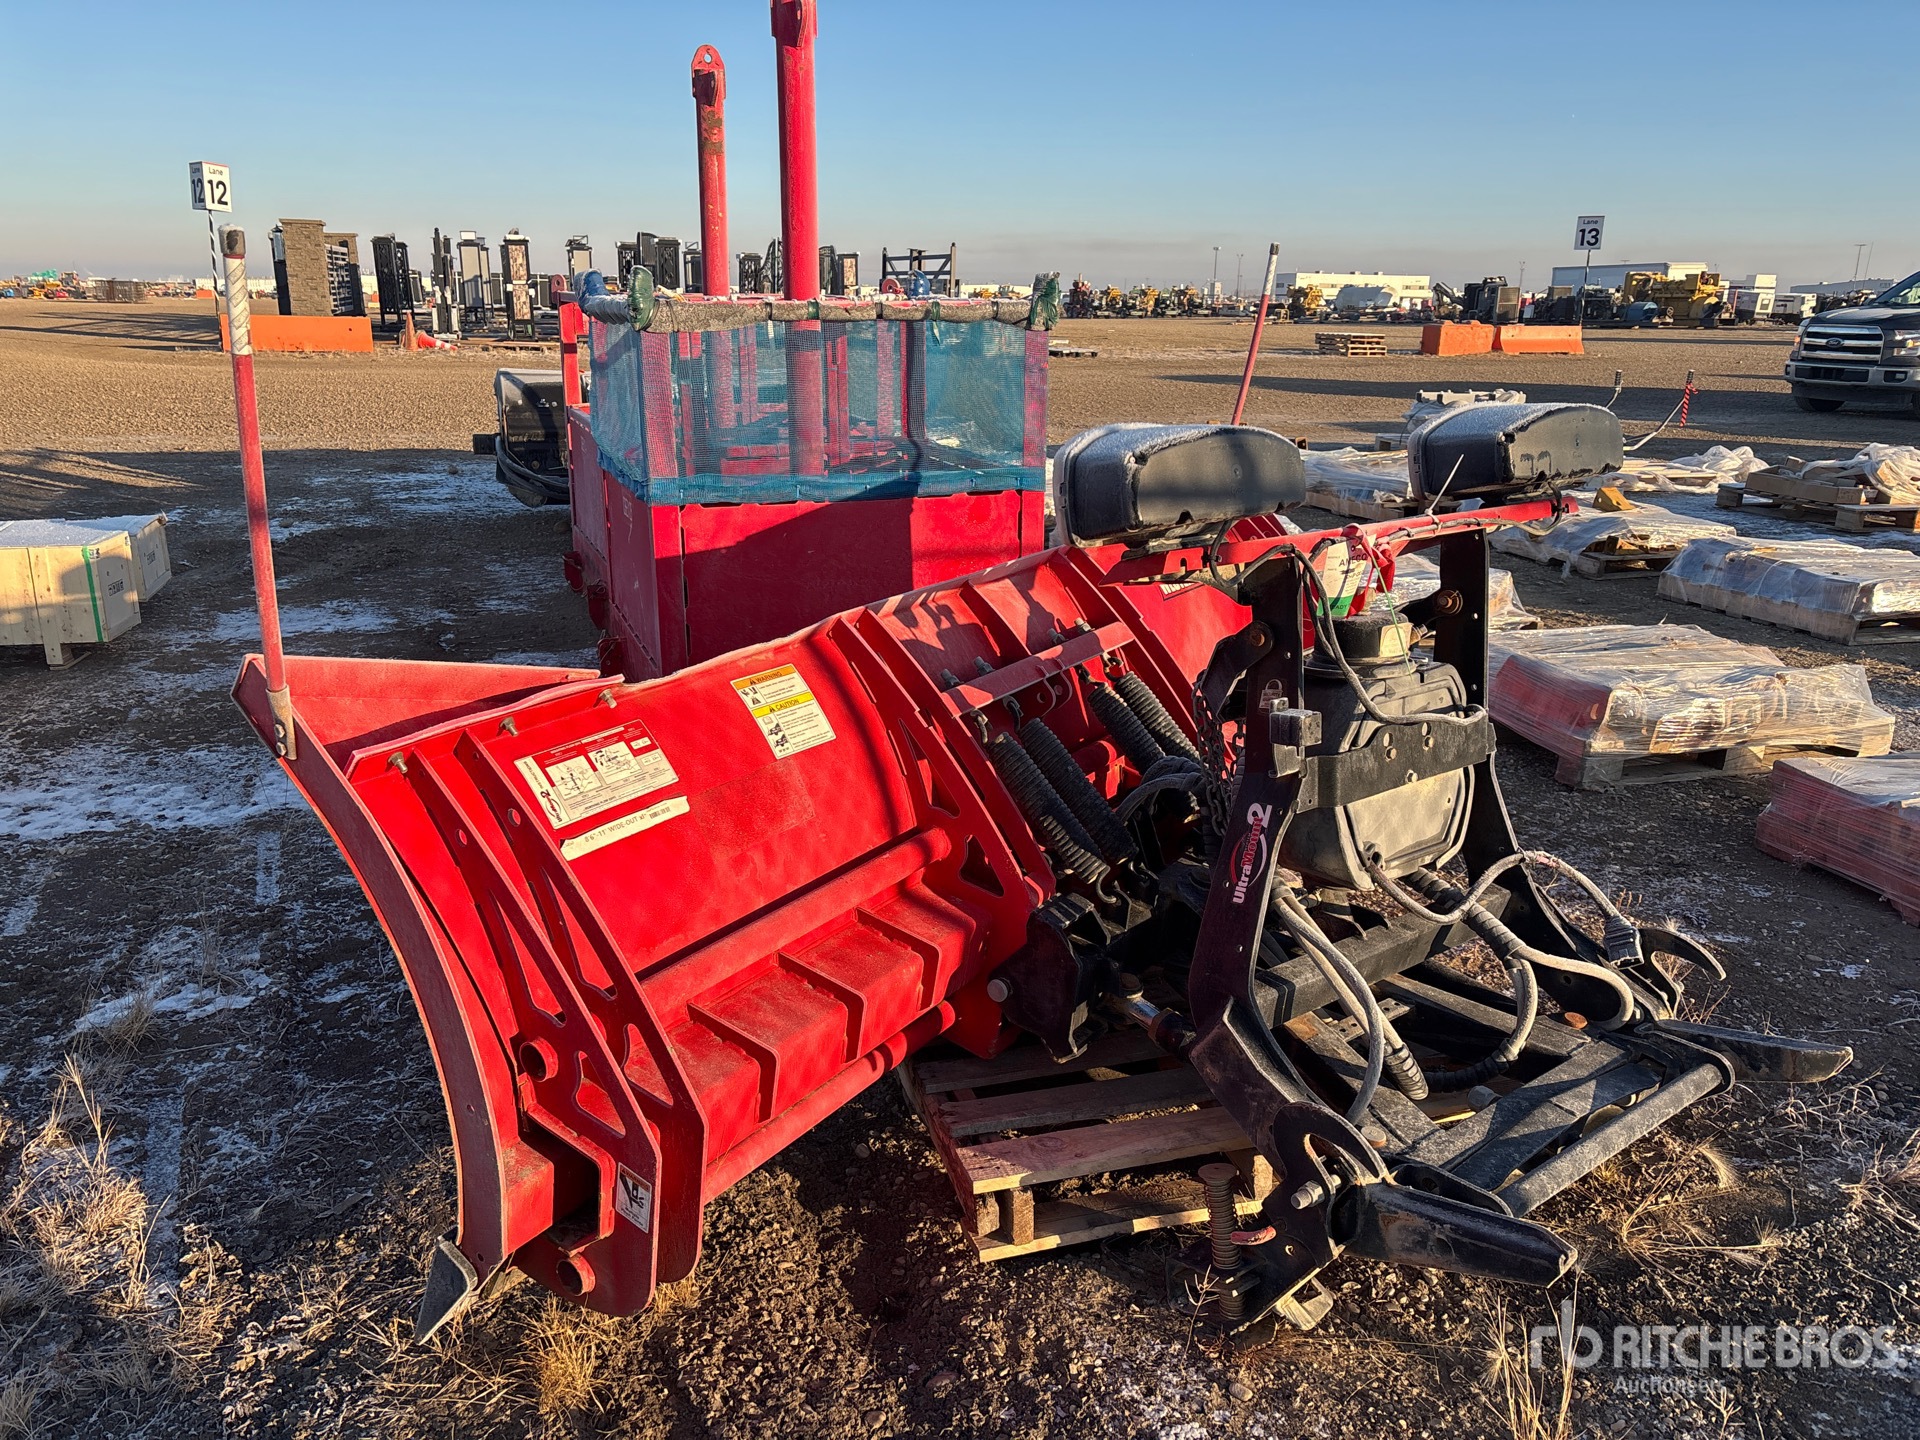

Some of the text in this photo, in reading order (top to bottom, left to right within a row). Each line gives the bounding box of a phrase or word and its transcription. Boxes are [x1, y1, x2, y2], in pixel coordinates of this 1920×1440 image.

[208, 166, 224, 176] Lane
[191, 177, 205, 204] 12
[207, 179, 228, 206] 12
[1578, 227, 1600, 247] 13
[756, 671, 782, 684] WARNING
[775, 698, 800, 712] CAUTION
[607, 815, 639, 833] WIDE-OUT
[1232, 816, 1264, 904] UltraMount
